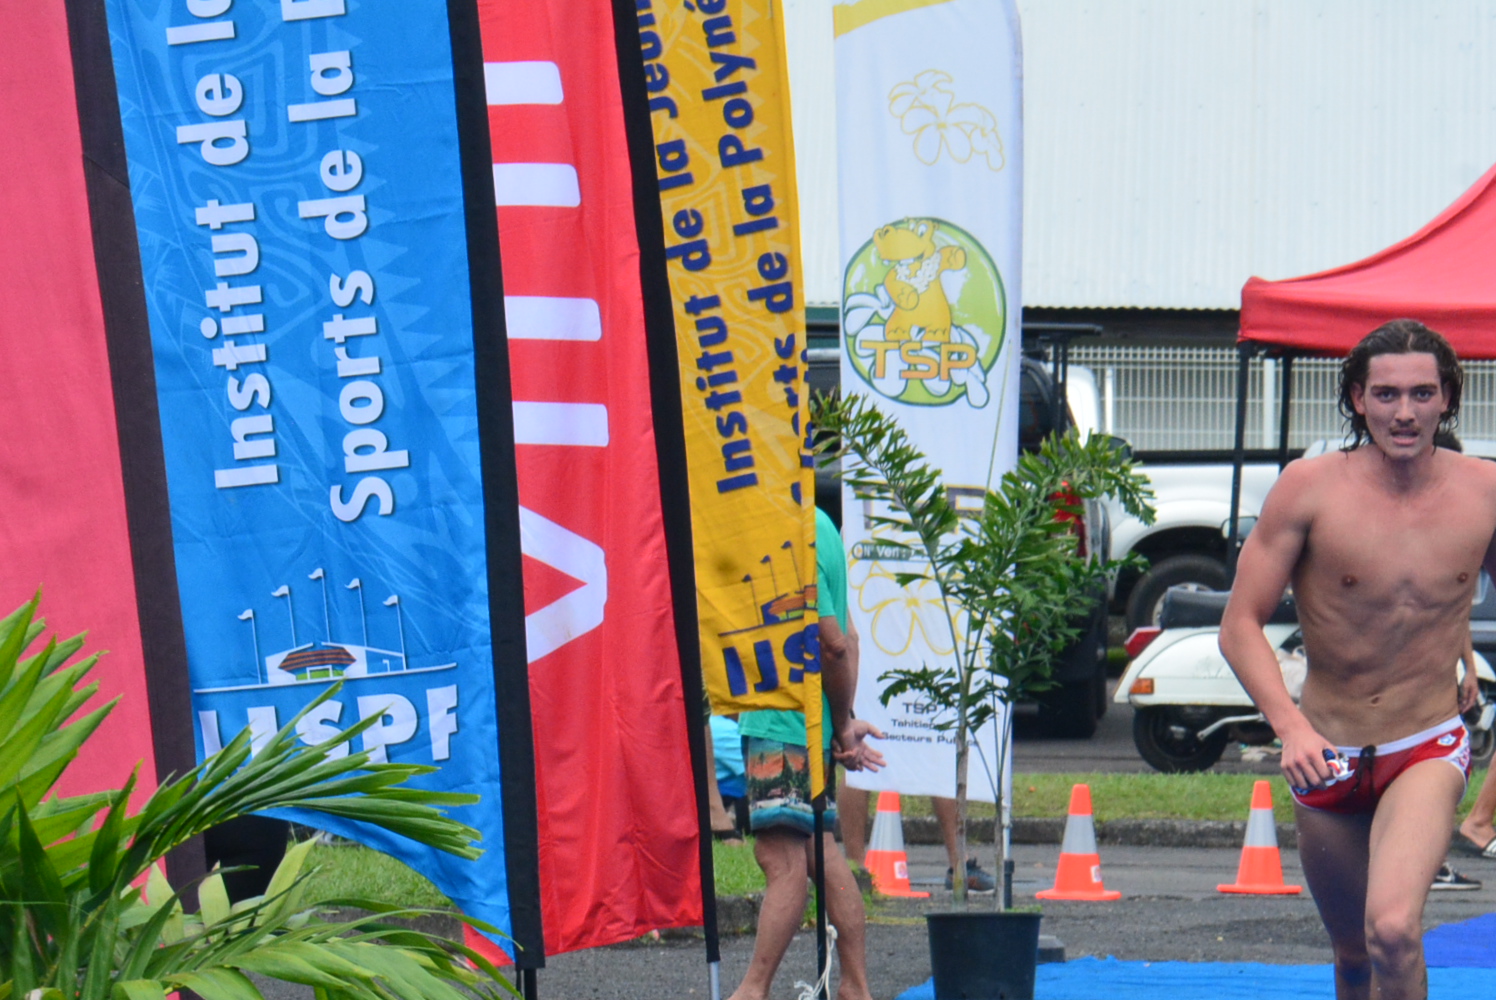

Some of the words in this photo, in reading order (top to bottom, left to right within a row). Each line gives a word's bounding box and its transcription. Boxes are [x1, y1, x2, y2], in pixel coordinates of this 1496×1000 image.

[176, 73, 249, 166] de
[287, 50, 357, 122] la
[297, 149, 369, 240] de
[657, 139, 695, 191] la
[664, 208, 712, 272] de
[733, 184, 779, 236] la
[746, 252, 793, 314] de
[194, 199, 280, 489] Institut
[859, 339, 978, 381] TSP
[322, 269, 409, 522] Sports
[684, 294, 758, 494] Institut
[902, 702, 938, 714] TSP
